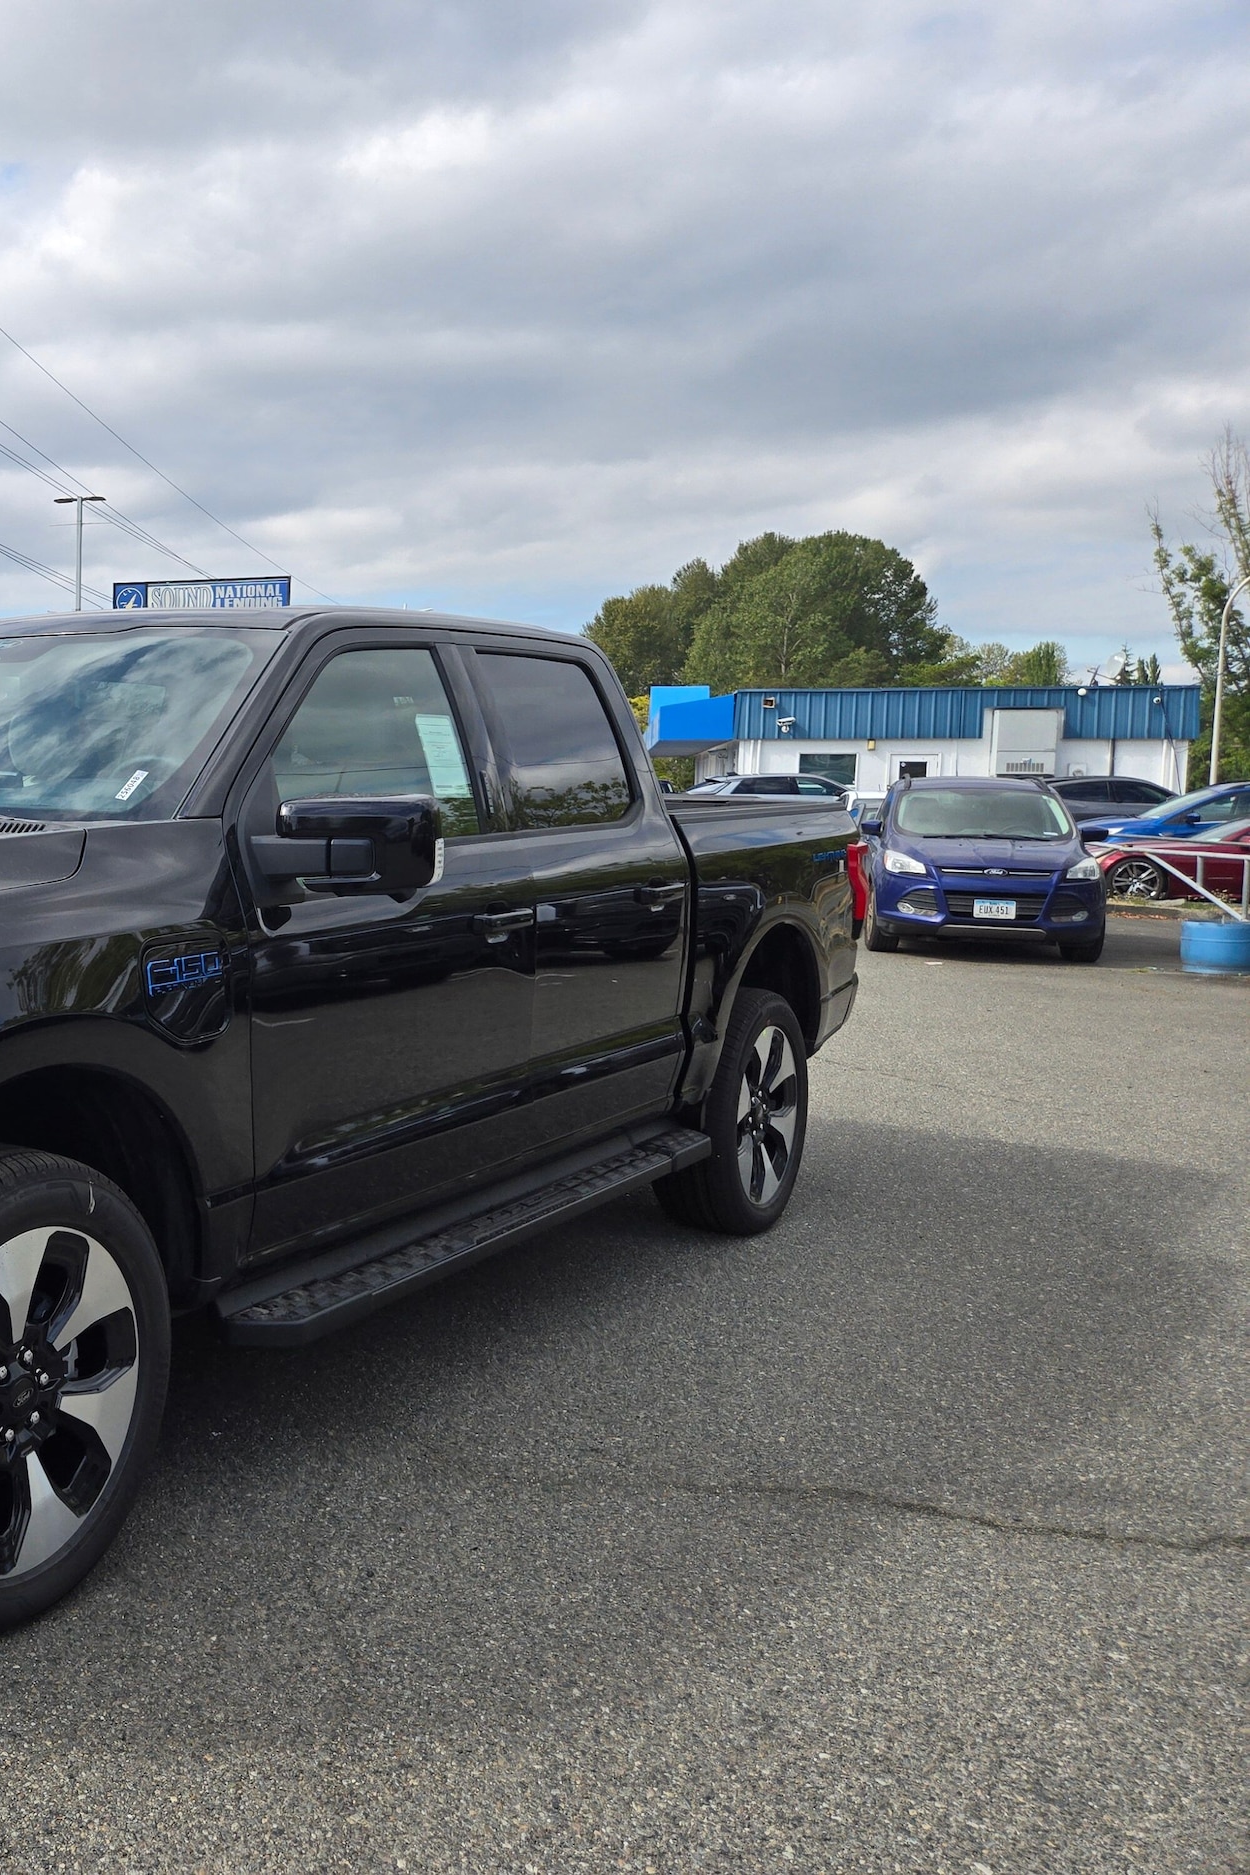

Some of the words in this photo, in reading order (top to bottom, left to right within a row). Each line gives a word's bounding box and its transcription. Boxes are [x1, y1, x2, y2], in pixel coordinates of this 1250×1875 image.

[151, 587, 211, 608] SOUND
[215, 584, 283, 598] NATIONAL
[979, 905, 993, 914] EUX
[995, 906, 1009, 915] 451
